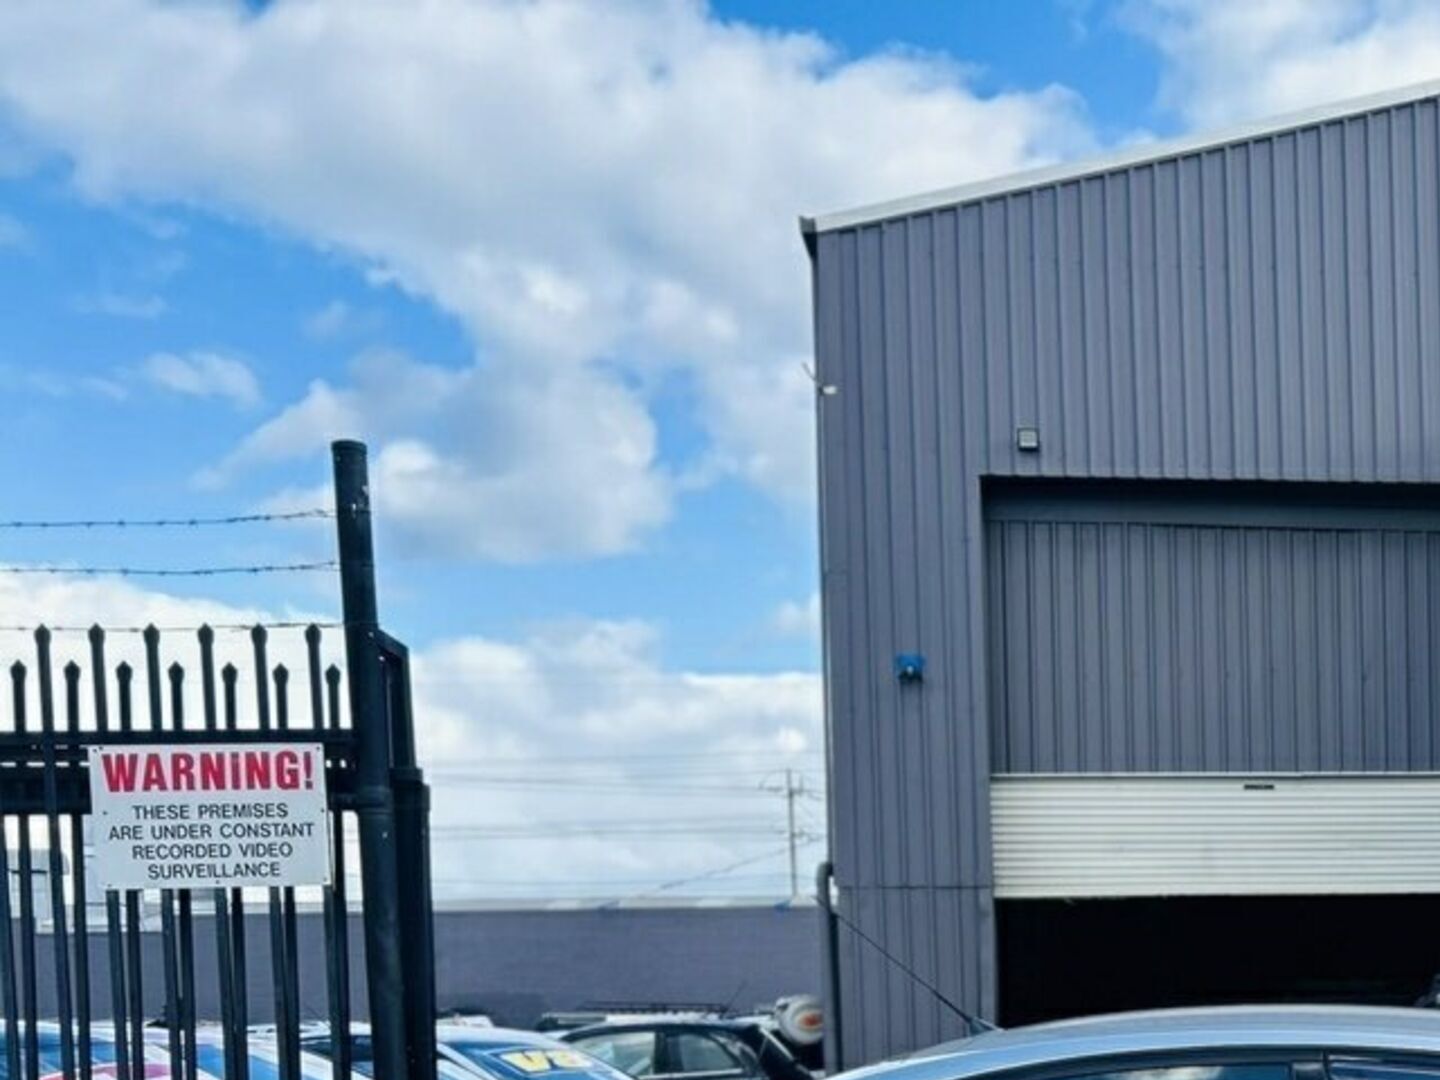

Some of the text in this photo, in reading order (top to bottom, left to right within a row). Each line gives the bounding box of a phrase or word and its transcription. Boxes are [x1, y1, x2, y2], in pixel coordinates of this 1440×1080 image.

[101, 750, 314, 792] WARNING!
[132, 803, 289, 820] THESE PREMISES
[109, 822, 314, 840] ARE UNDER CONSTANT
[132, 842, 293, 860] RECORDED VIDEO
[148, 862, 281, 880] SURVEILLANCE
